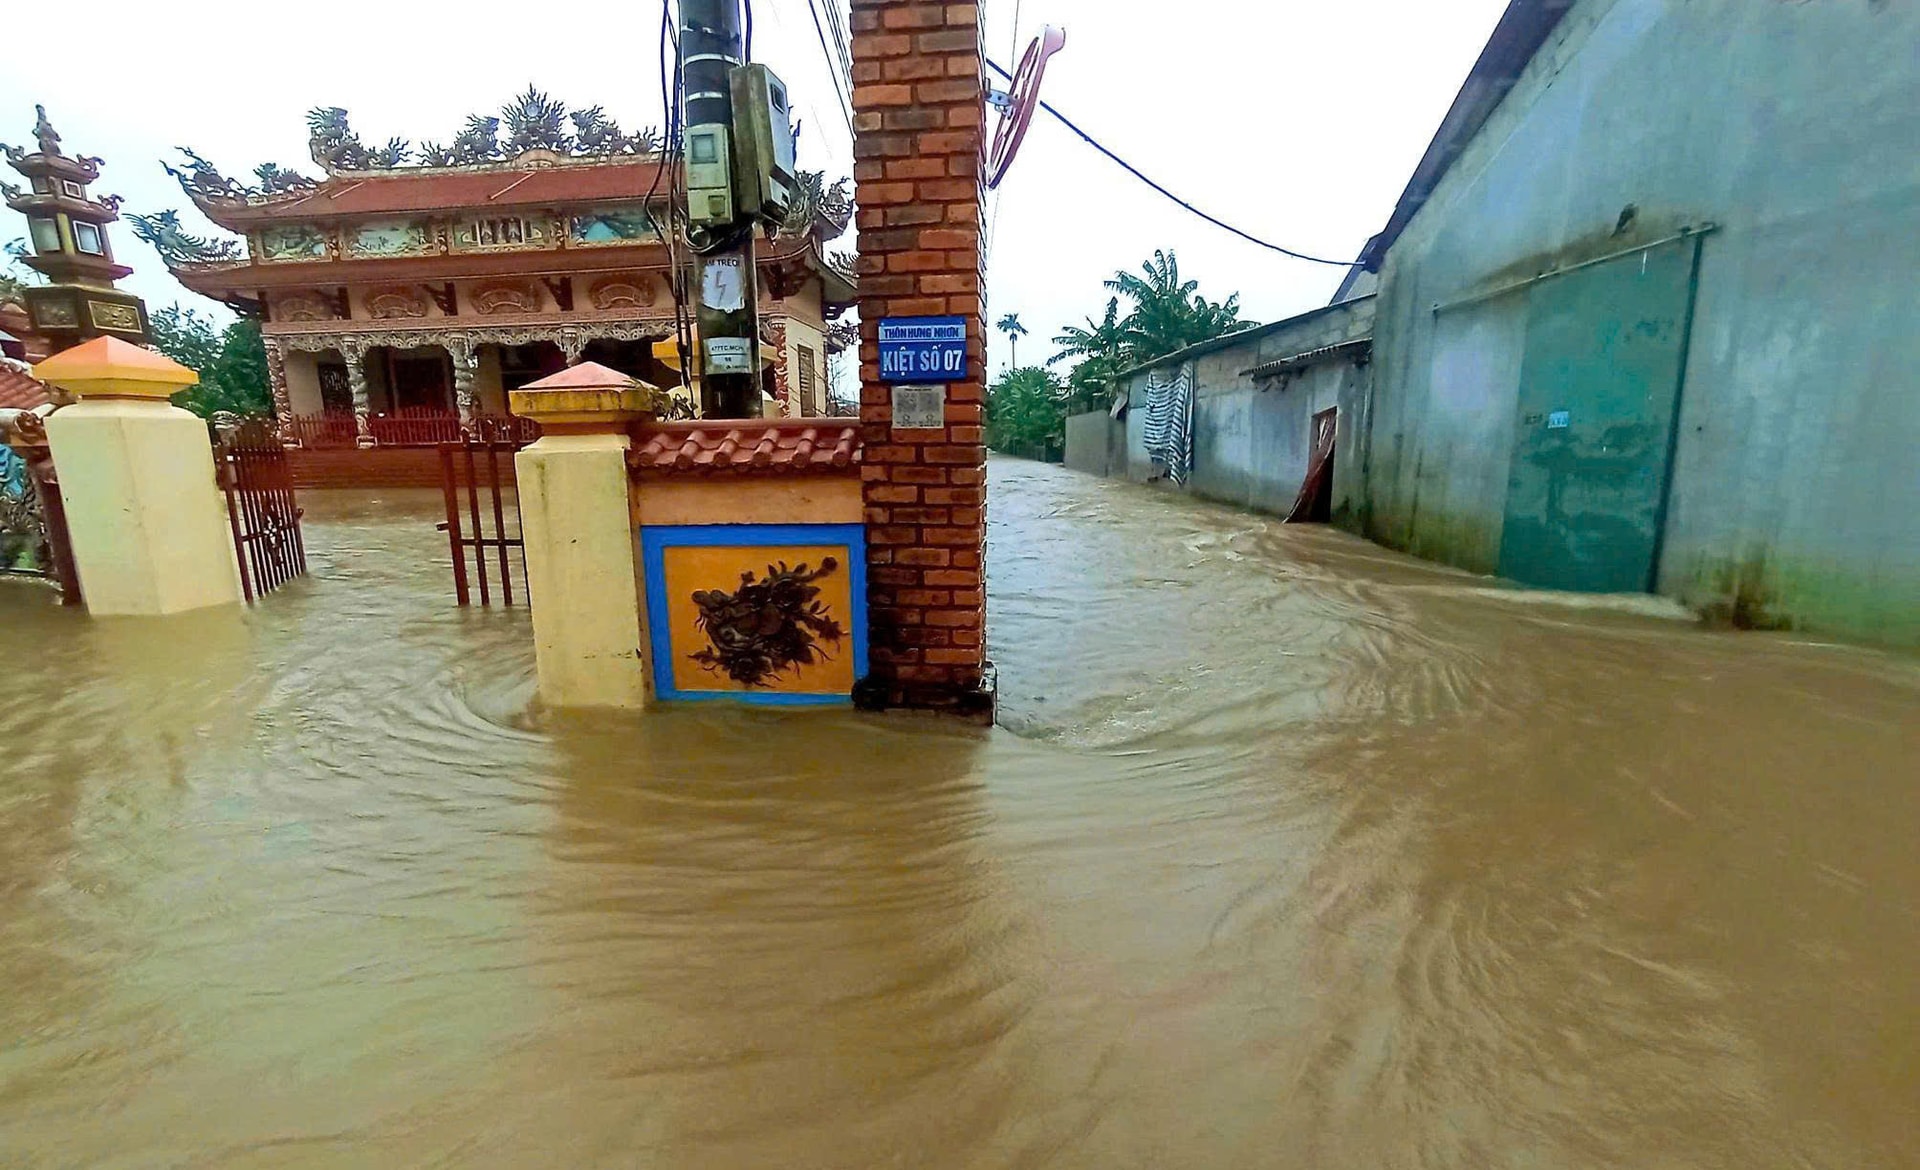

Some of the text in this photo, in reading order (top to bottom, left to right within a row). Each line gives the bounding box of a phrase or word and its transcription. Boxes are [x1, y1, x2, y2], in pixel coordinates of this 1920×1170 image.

[884, 326, 907, 339] THÔN
[883, 344, 963, 376] KIỆT SỐ 07
